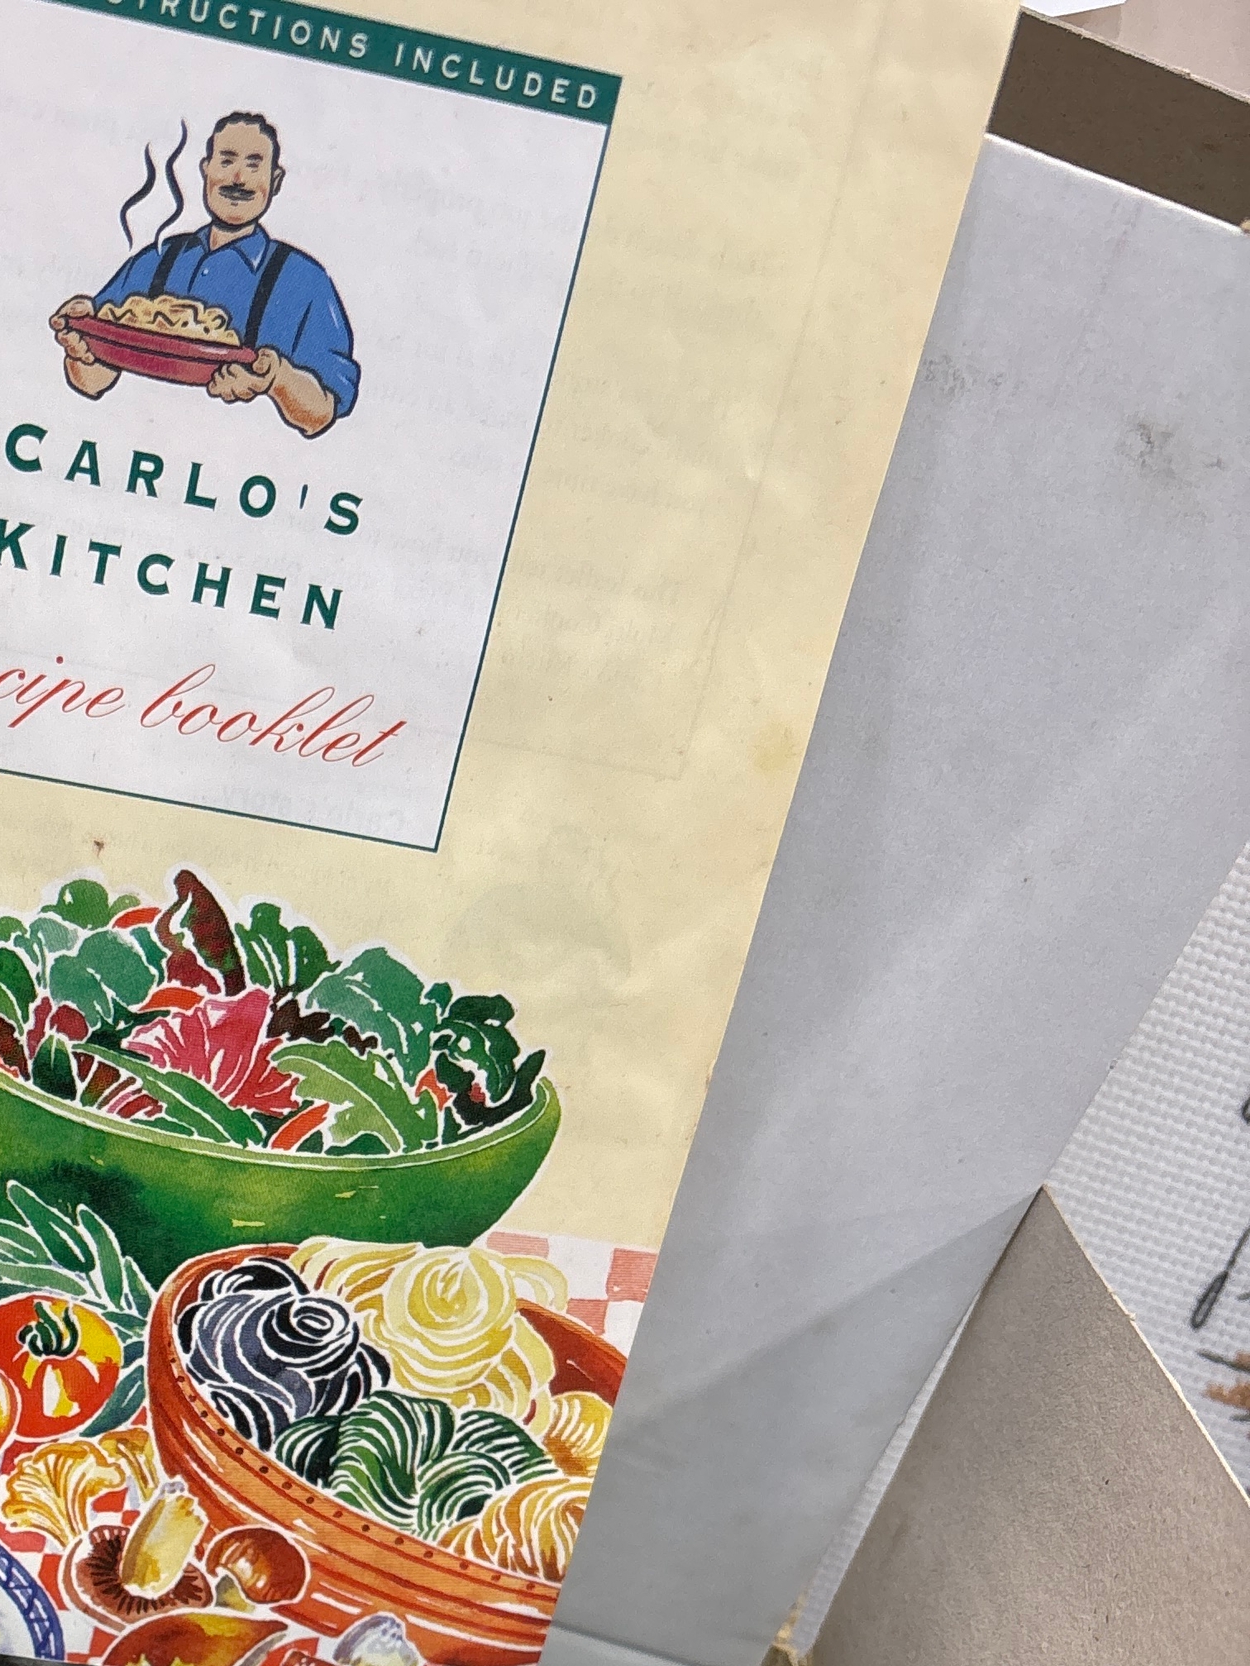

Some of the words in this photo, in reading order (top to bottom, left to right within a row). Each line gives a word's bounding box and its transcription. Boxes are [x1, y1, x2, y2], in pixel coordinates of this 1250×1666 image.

[108, 0, 368, 59] RUCTIONS
[394, 43, 598, 110] INCLUDED
[4, 423, 365, 537] CARLO'S
[140, 663, 410, 770] booklet
